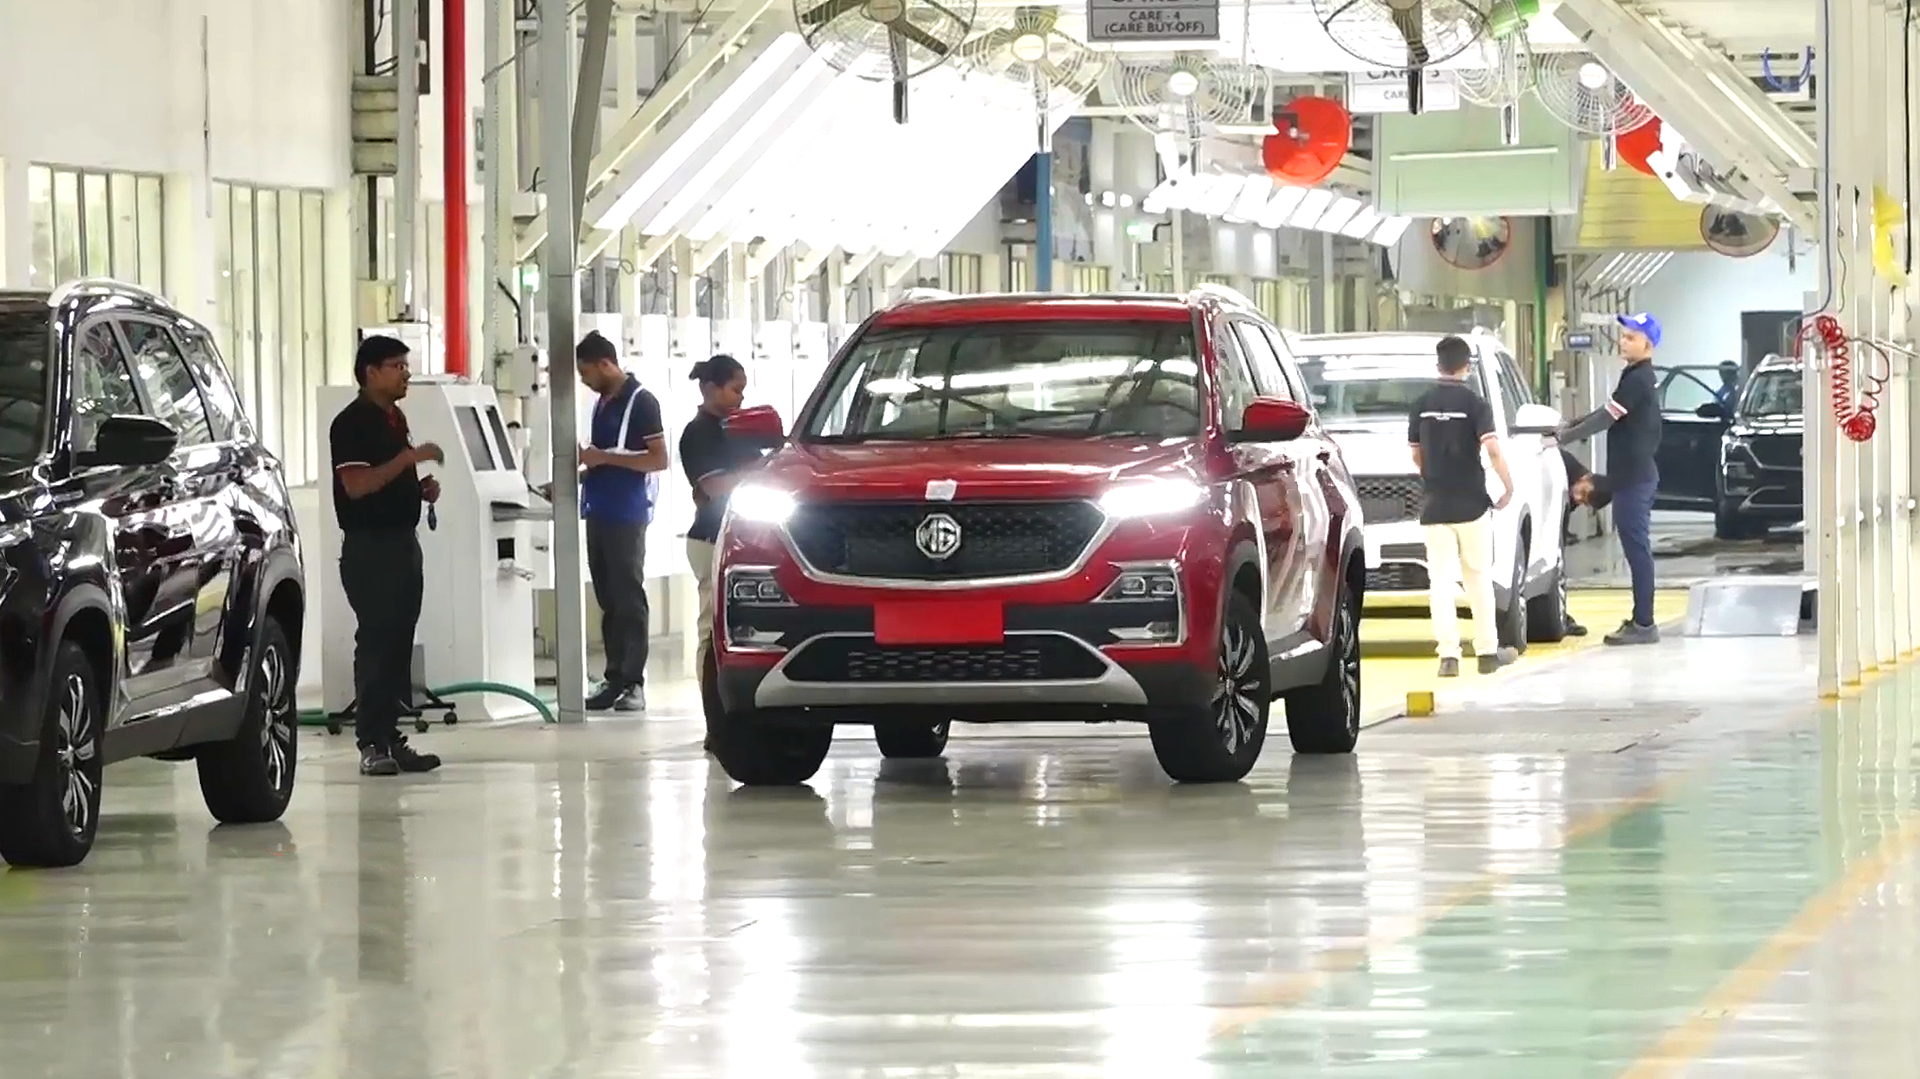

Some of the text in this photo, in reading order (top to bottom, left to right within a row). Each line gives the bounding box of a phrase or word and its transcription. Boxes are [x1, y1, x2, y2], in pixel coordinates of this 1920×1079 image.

[1128, 10, 1164, 21] CARE
[1173, 10, 1181, 21] 4
[1104, 22, 1145, 34] (CARE
[1383, 90, 1407, 101] CAR
[918, 517, 957, 554] MG
